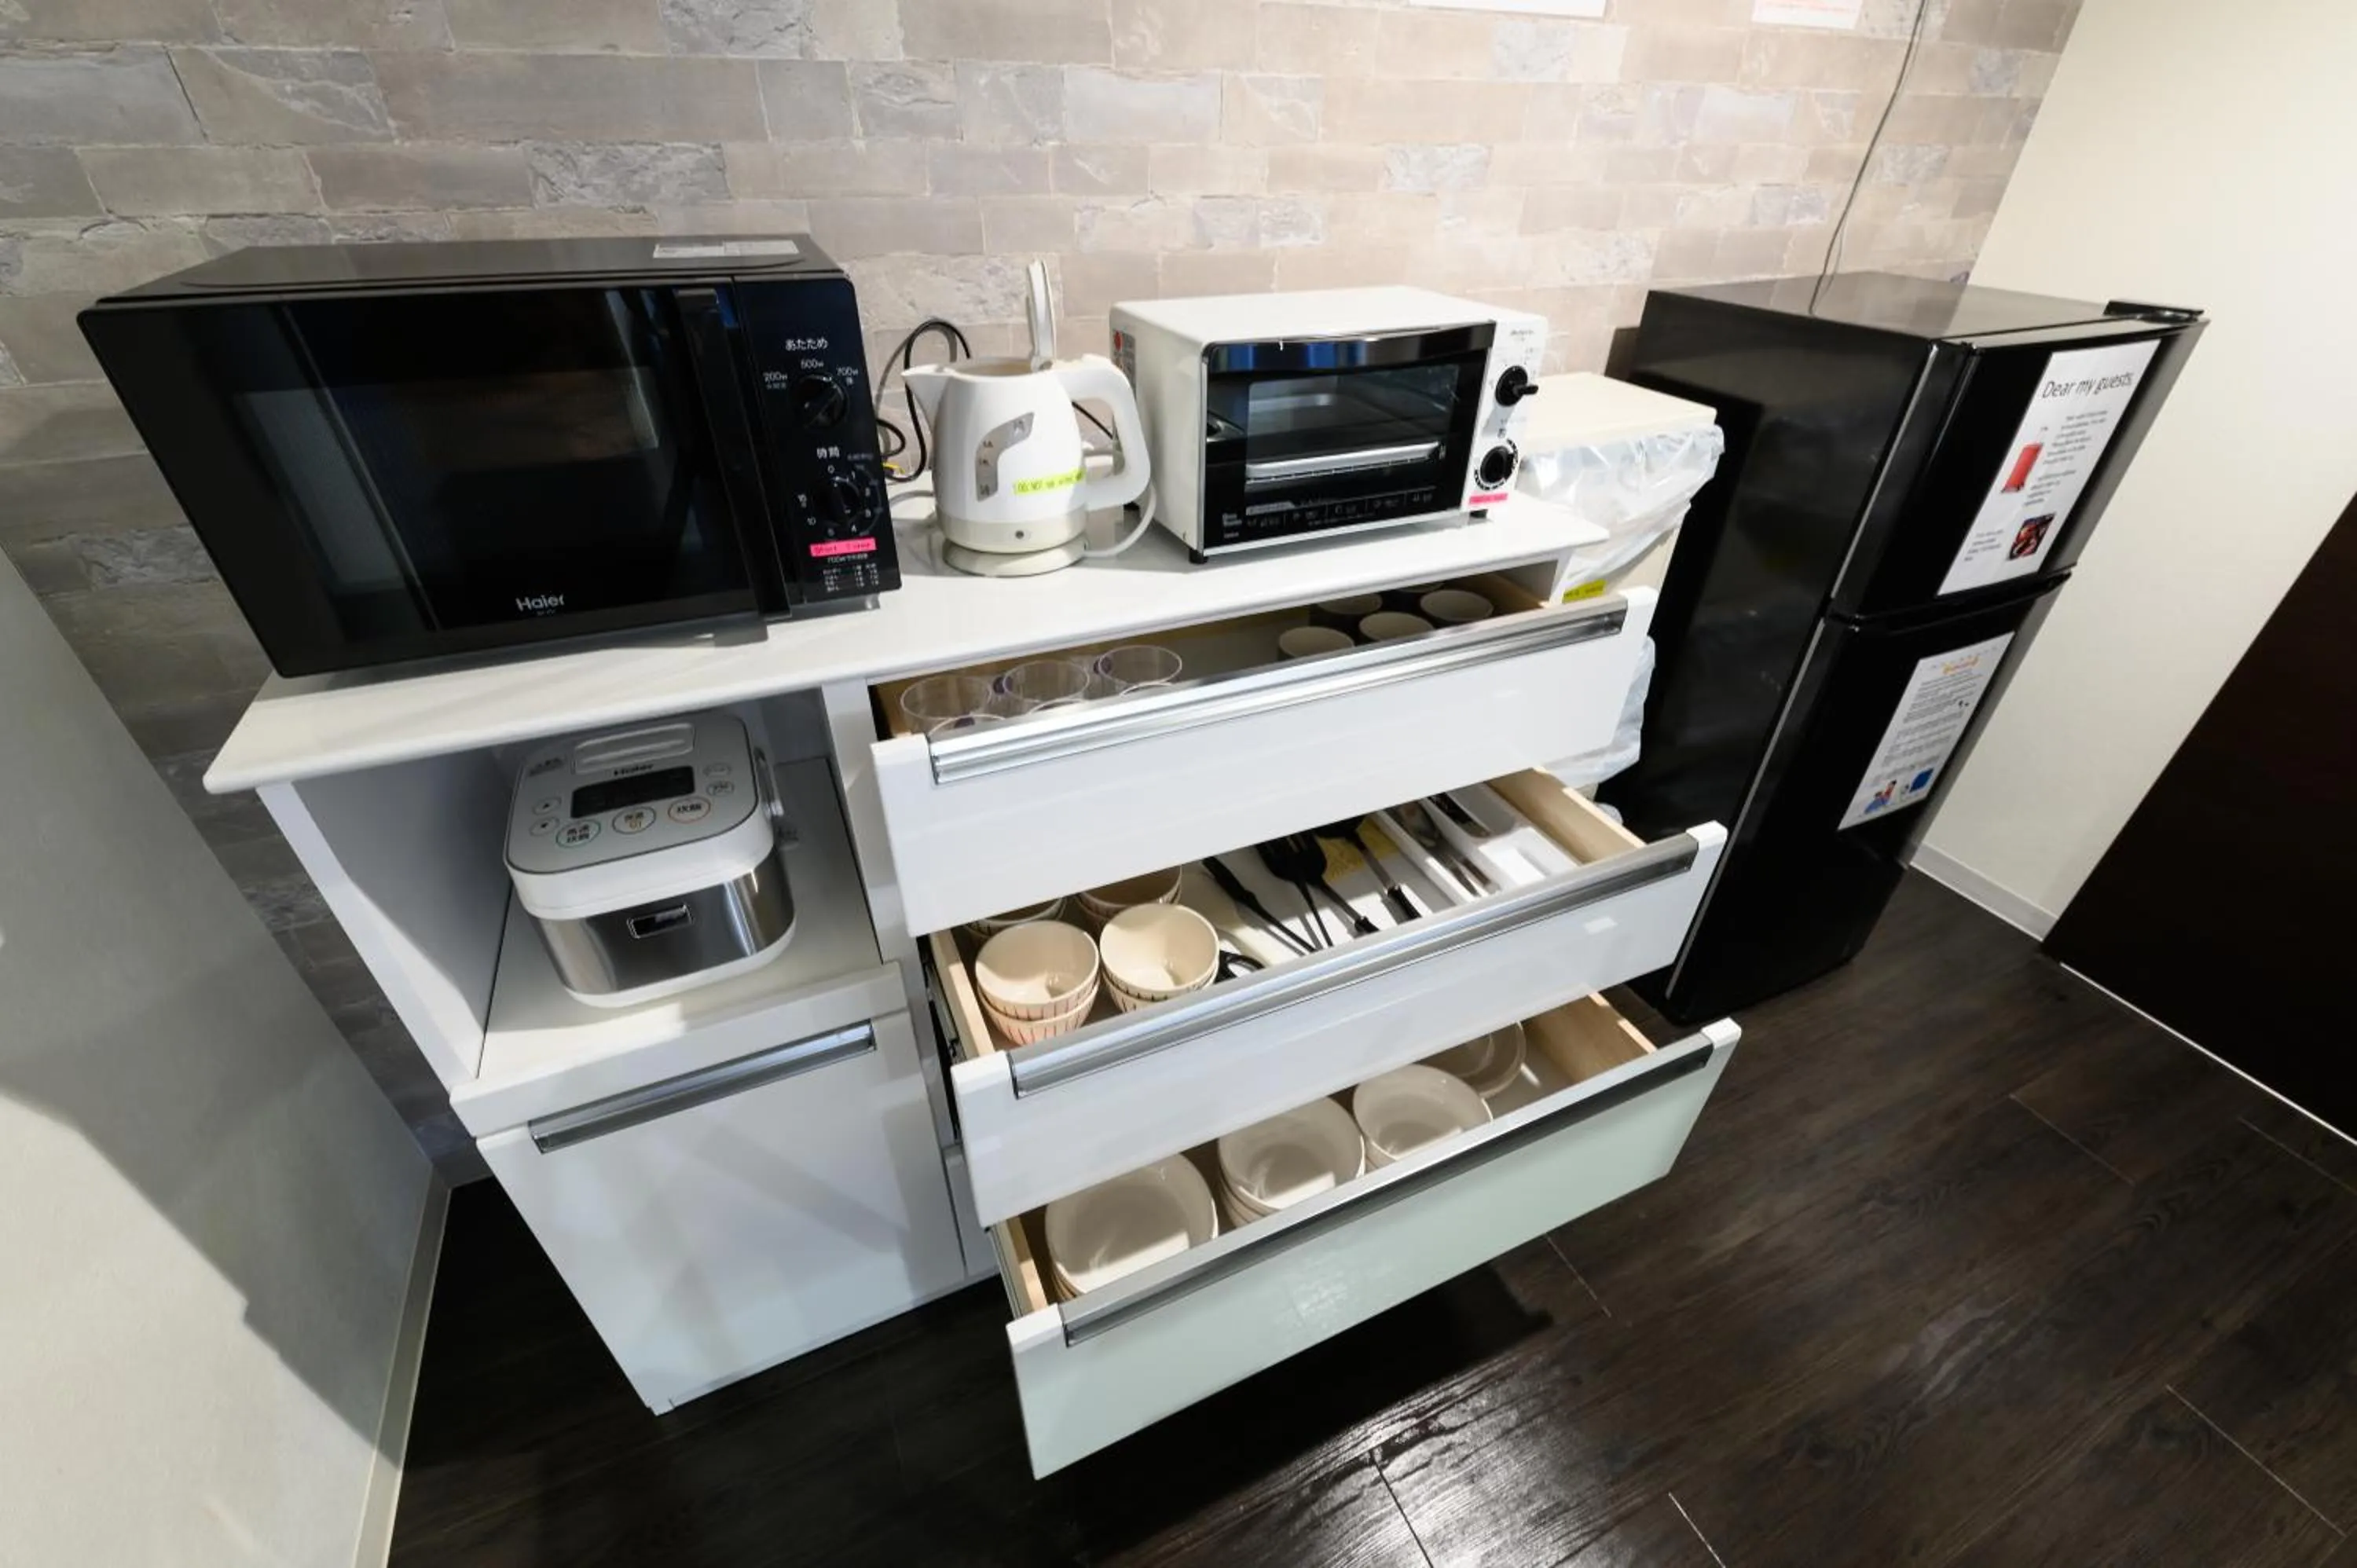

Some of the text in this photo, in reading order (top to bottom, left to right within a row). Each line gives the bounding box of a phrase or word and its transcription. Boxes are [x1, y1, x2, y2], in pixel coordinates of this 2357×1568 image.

[2042, 372, 2135, 398] Dear my guests
[515, 594, 565, 612] Haier
